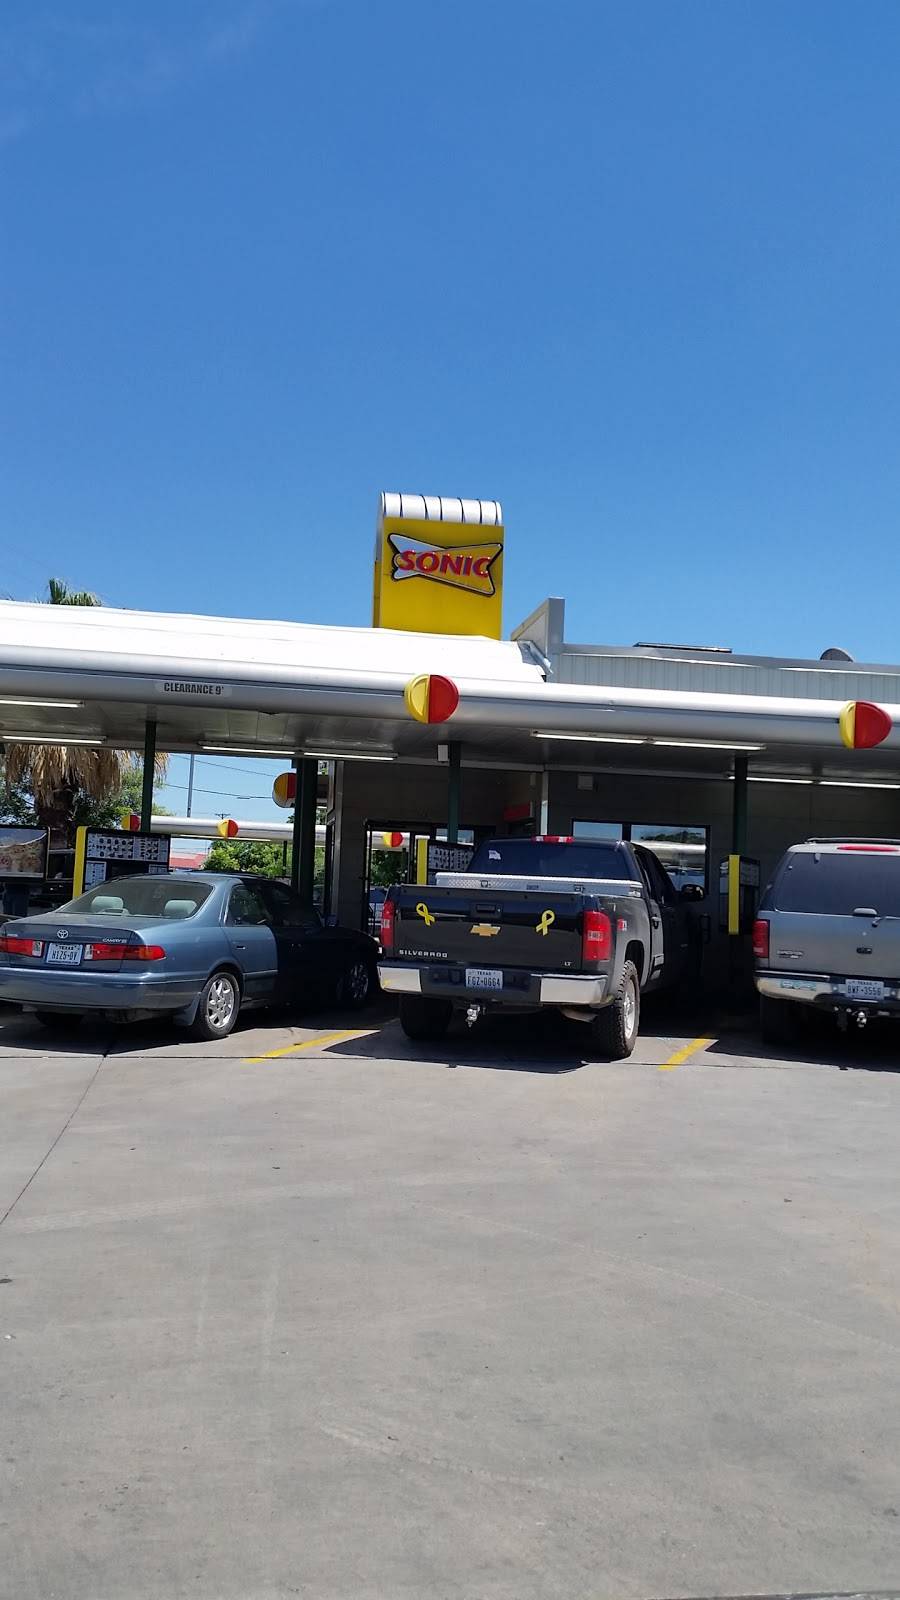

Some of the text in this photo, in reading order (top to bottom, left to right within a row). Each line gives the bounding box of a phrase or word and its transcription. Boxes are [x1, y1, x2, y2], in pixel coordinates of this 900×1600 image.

[399, 550, 491, 578] SONIC
[164, 682, 224, 695] CLEARANCE 9'
[399, 949, 448, 958] SILVERADO
